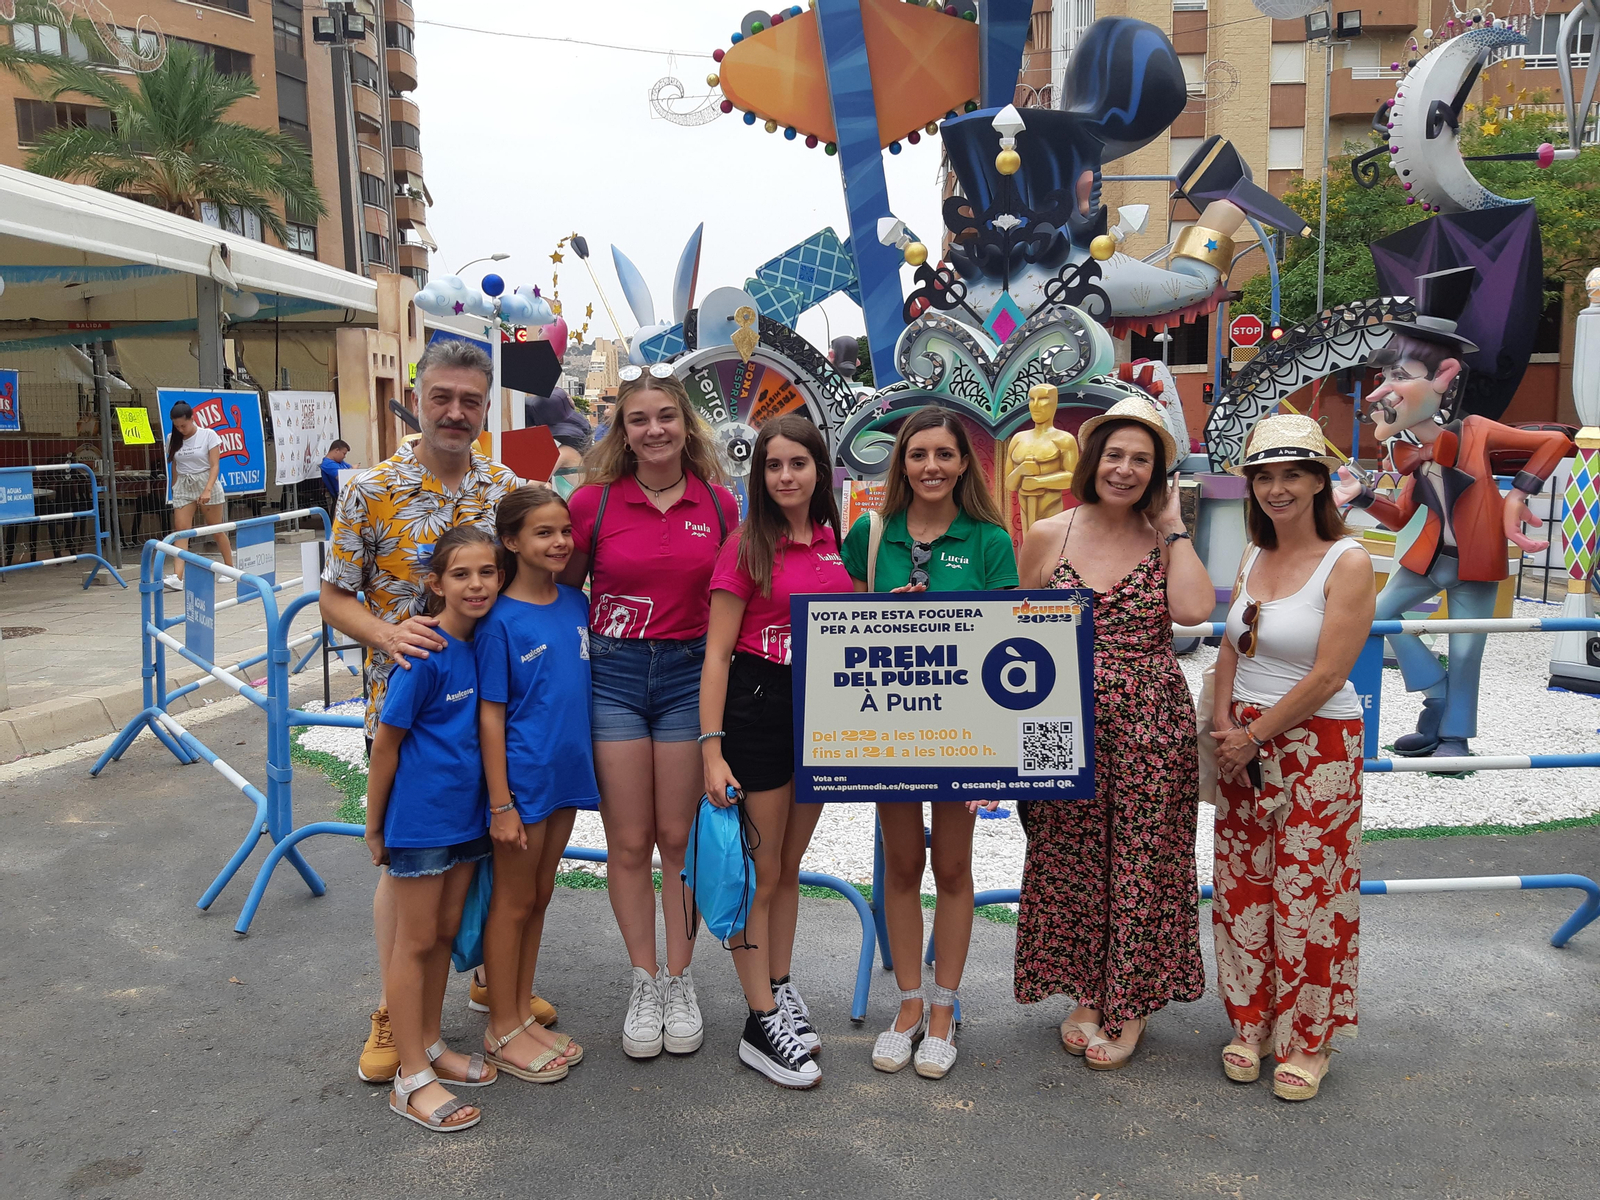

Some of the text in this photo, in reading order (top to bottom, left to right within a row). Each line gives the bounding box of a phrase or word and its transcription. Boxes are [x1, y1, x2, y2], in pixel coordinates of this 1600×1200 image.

[1233, 327, 1261, 335] STOP
[740, 362, 756, 399] BONA
[695, 368, 728, 423] terra
[729, 361, 745, 422] VESPRADA
[699, 406, 714, 424] VIVA
[228, 470, 260, 486] TENIS!
[684, 520, 711, 533] Paula
[940, 551, 970, 565] Lucía
[811, 608, 983, 621] VOTA PER ESTA FOGUERA
[1012, 602, 1082, 616] FOGUERES
[1017, 613, 1073, 624] 2022
[820, 622, 975, 635] PER A ACONSEGUIR EL:
[844, 644, 958, 669] PREMI
[1000, 645, 1037, 694] à
[833, 669, 969, 687] DEL PÚBLIC
[860, 688, 942, 712] À Punt
[812, 729, 972, 742] Del 22 a les 10:00 h
[812, 745, 997, 758] fins al 24 a les 10:00 h.
[813, 782, 938, 792] www.apuntmedia.es/fogueres
[951, 779, 1075, 790] O escaneja este codi QR.
